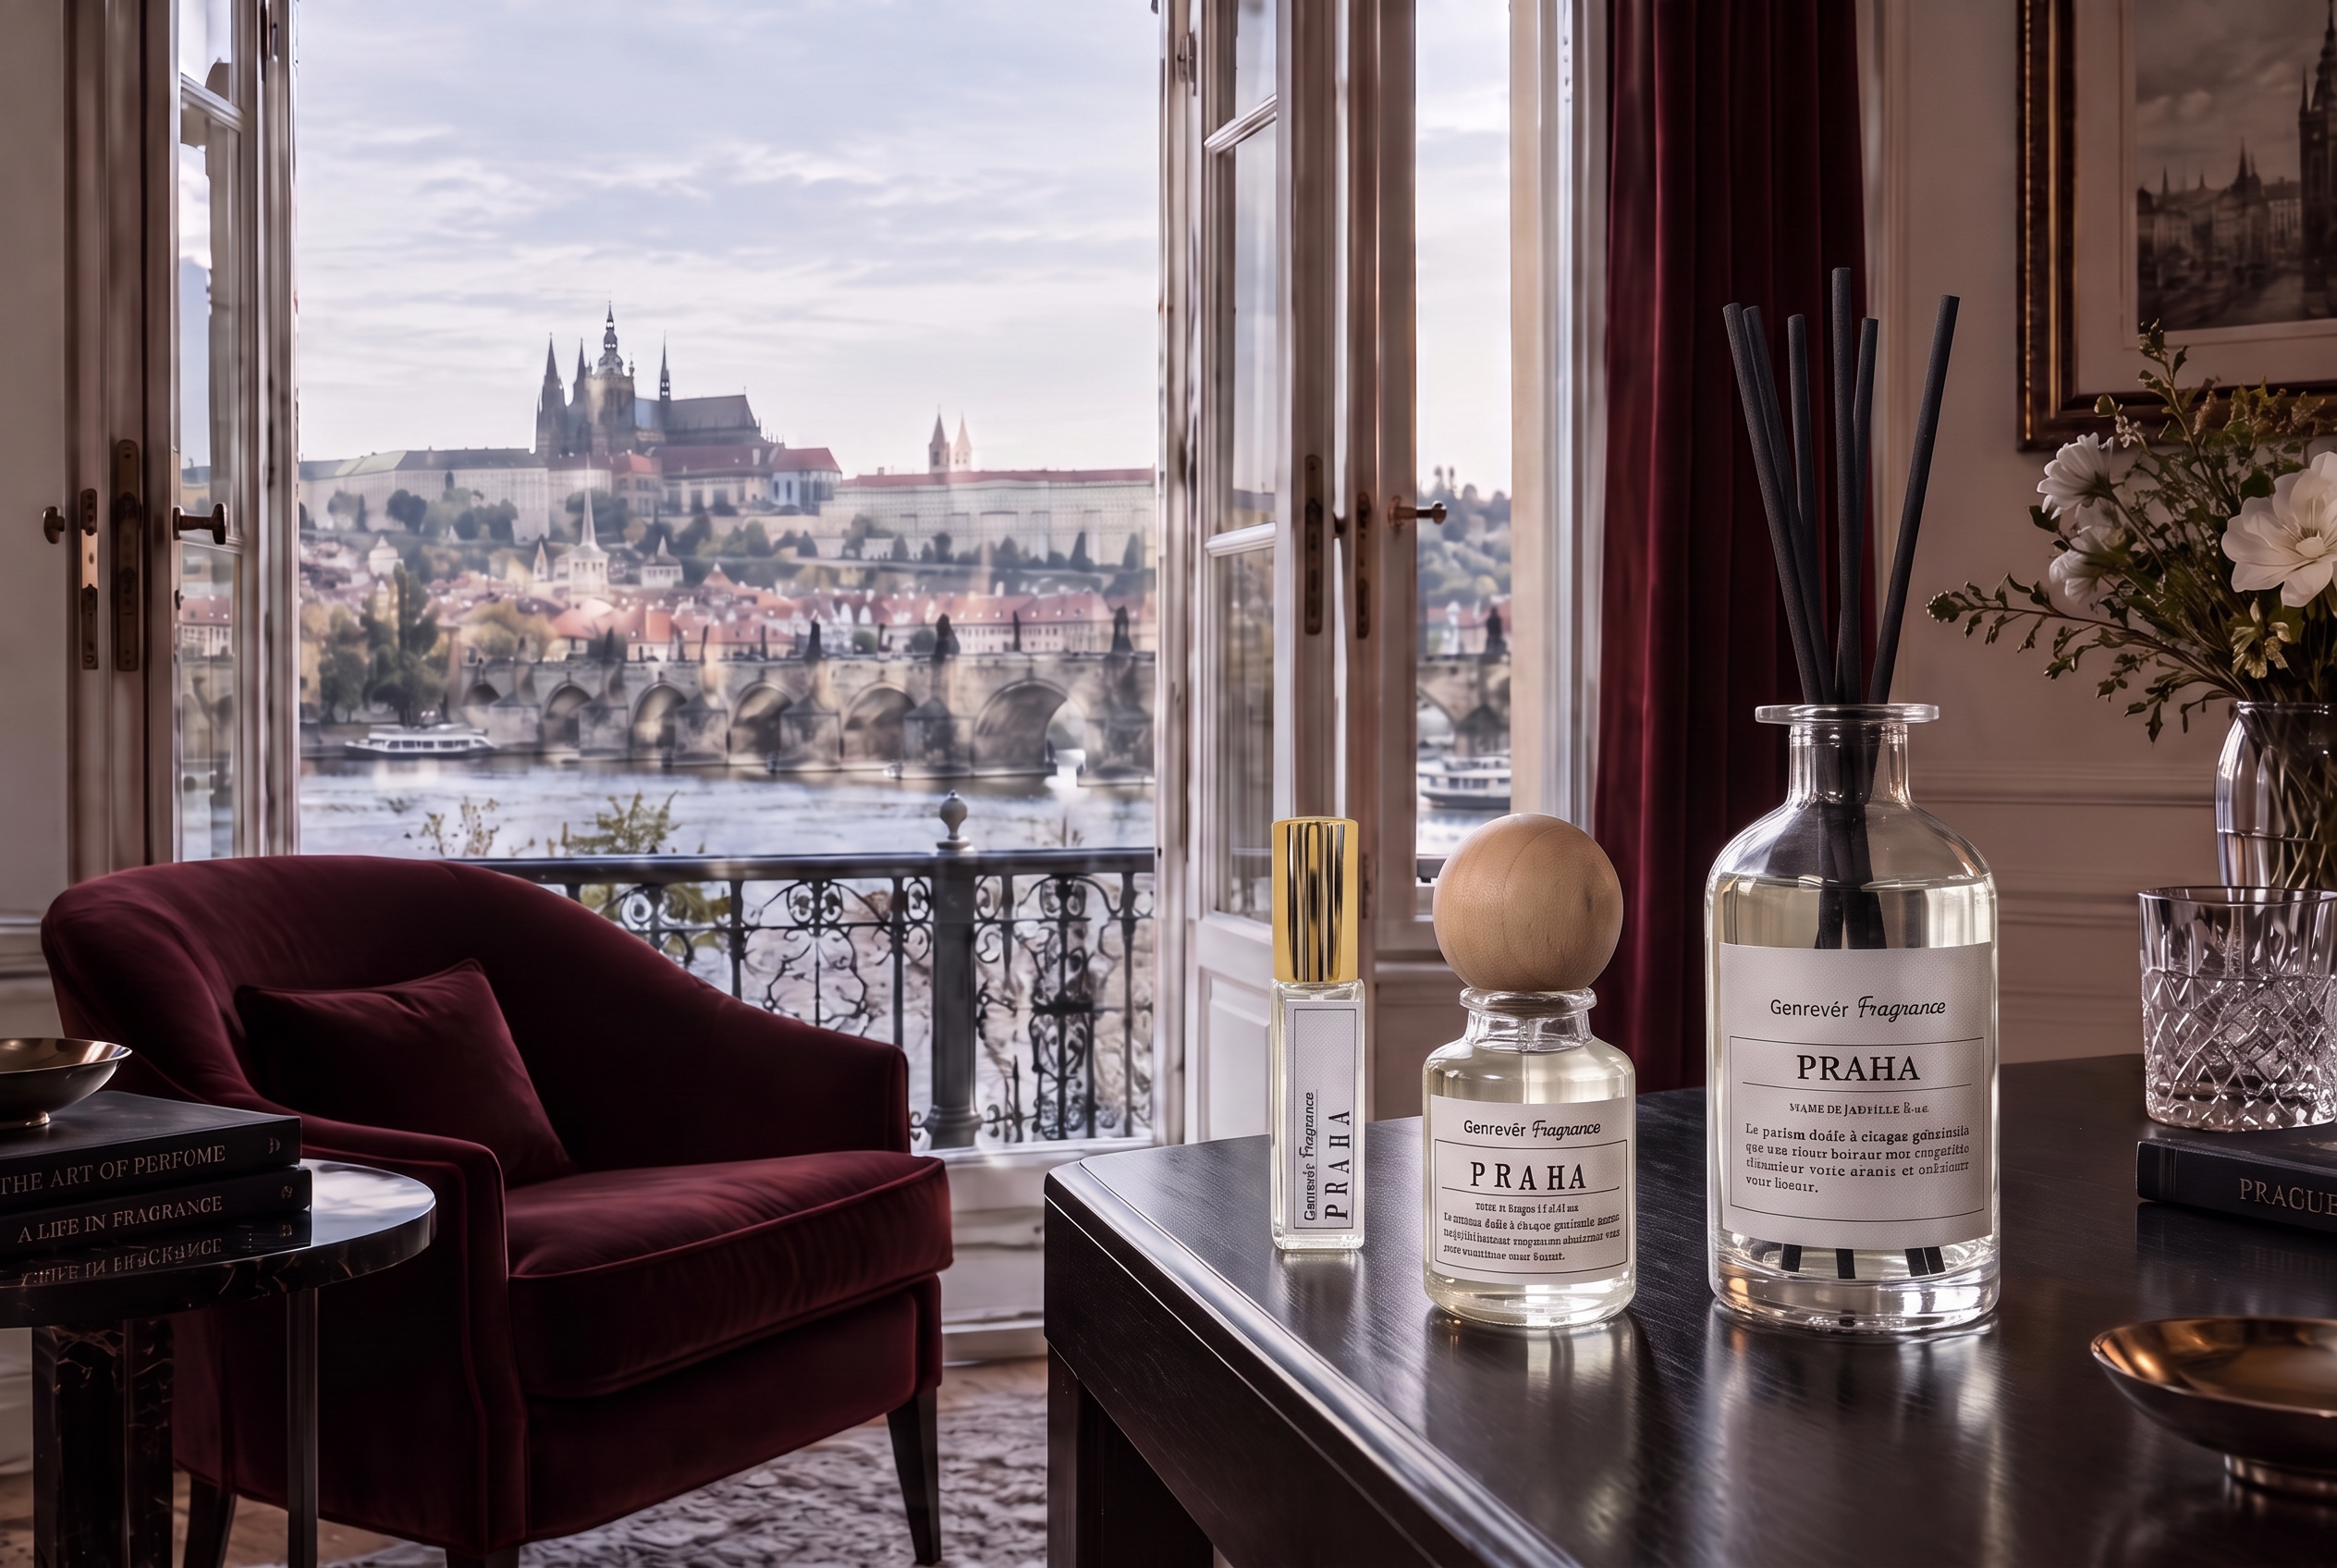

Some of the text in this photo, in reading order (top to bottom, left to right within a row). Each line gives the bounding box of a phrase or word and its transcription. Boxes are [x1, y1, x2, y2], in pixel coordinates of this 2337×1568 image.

[1770, 995, 1945, 1023] Genrevér Fragrance
[1796, 1055, 1920, 1081] PRAHA
[1828, 1106, 1841, 1114] DE
[1533, 1120, 1601, 1141] Fragrance
[1850, 1131, 1857, 1142] à
[0, 1145, 226, 1195] THE ART OF PERFOME
[1325, 1110, 1350, 1220] PRAHA
[1470, 1161, 1586, 1191] PRAHA
[18, 1196, 223, 1243] A LIFE IN FRAGRANCE
